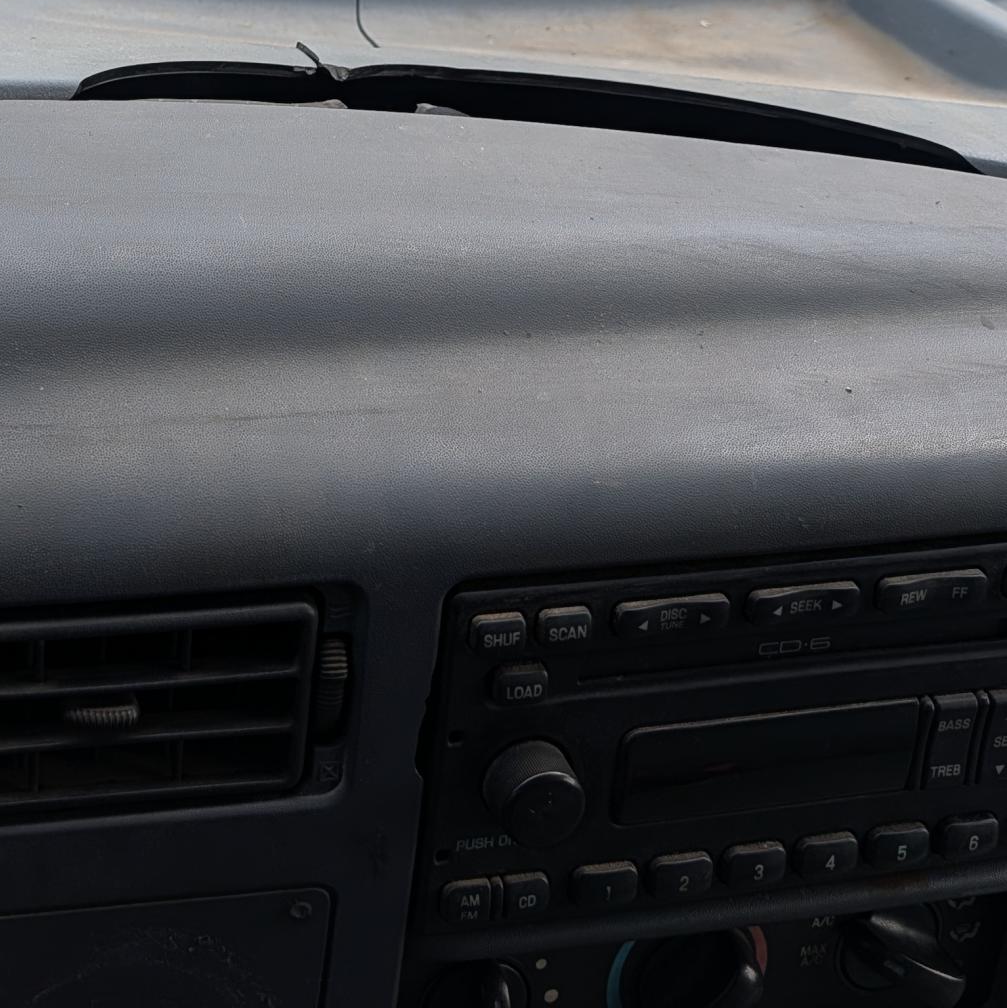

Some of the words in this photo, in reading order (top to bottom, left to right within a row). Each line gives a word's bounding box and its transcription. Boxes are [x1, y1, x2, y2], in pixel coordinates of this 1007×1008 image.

[900, 589, 928, 606] REW
[952, 586, 968, 600] FF
[660, 608, 688, 622] DISC
[789, 599, 823, 615] SEEK
[483, 631, 521, 649] SHUF
[548, 624, 588, 642] SCAN
[505, 684, 543, 700] LOAD
[937, 718, 971, 732] BASS
[930, 764, 961, 777] TREB
[456, 837, 494, 852] PUSH
[968, 835, 979, 851] 6
[897, 845, 908, 861] 5
[825, 855, 836, 871] 4
[753, 864, 764, 880] 3
[678, 875, 690, 892] 2
[460, 894, 480, 907] AM
[518, 894, 537, 909] CD
[604, 885, 612, 902] 1
